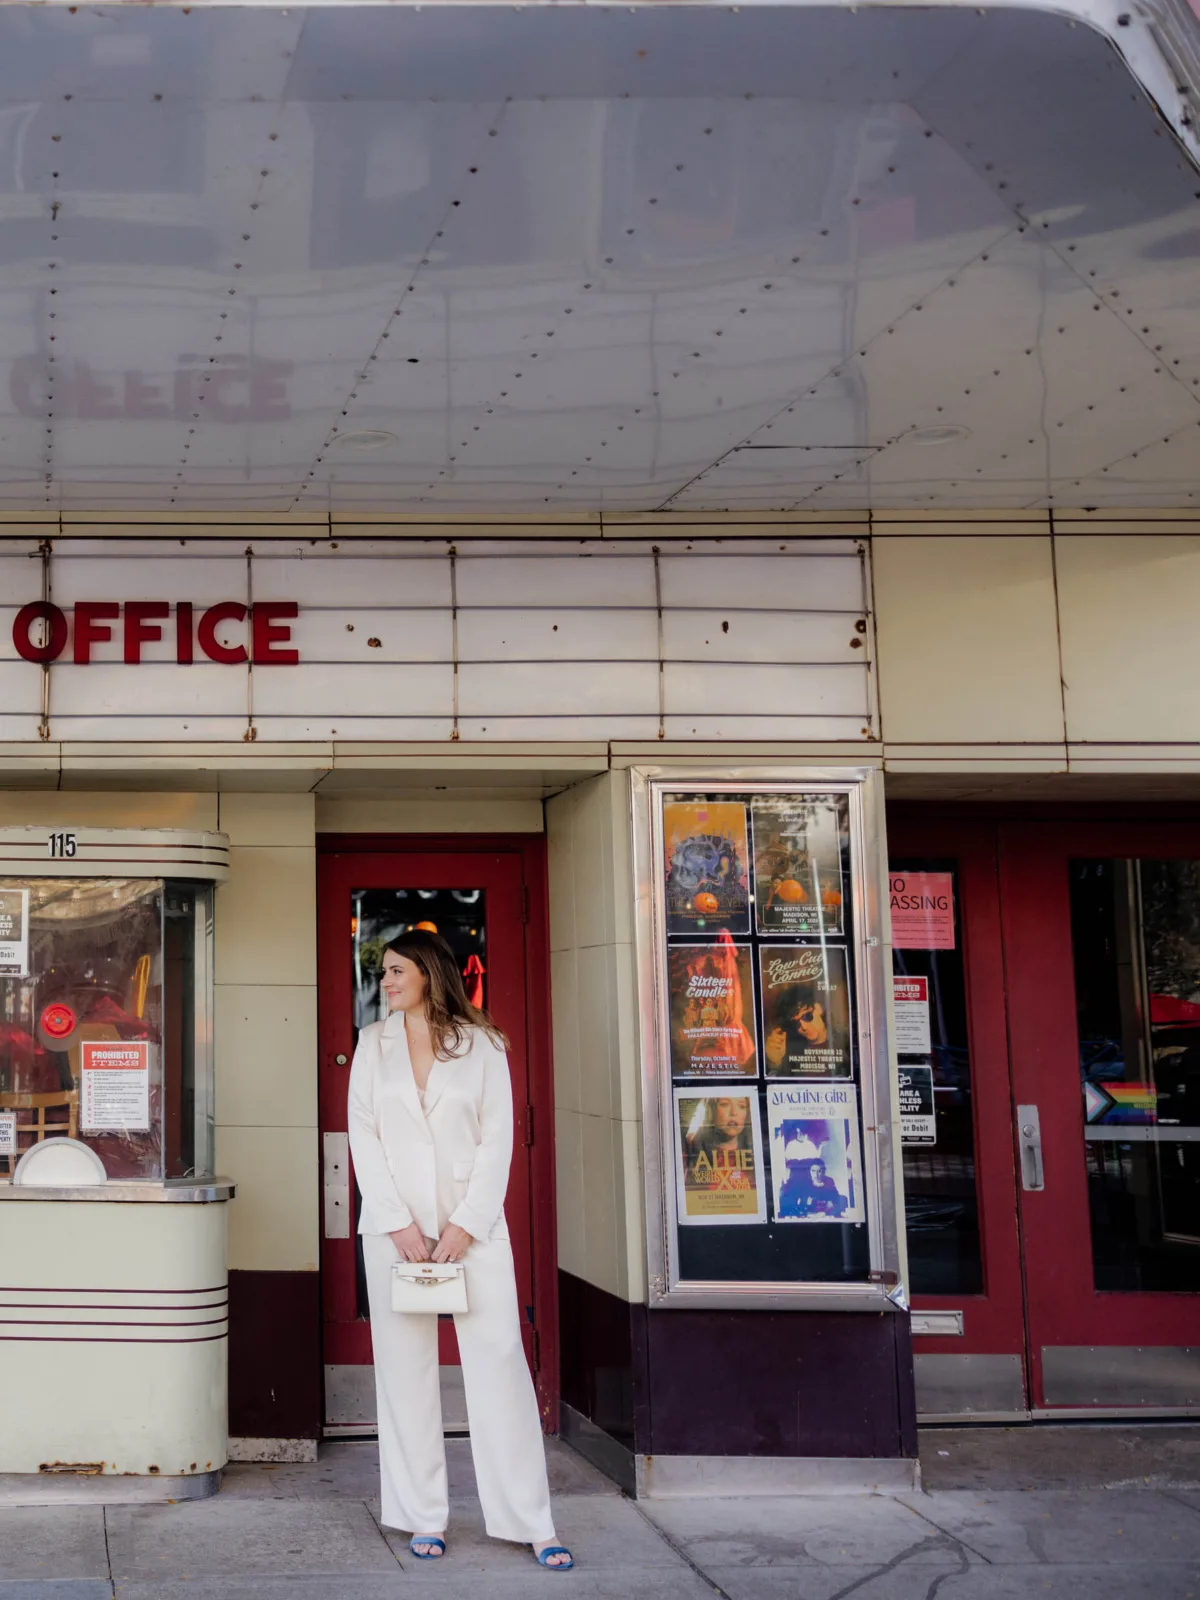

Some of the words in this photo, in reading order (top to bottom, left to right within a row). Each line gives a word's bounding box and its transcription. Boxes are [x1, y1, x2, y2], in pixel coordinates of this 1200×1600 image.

[12, 600, 299, 665] OFFICE
[48, 833, 76, 857] 115
[890, 878, 905, 892] O
[890, 896, 948, 910] ASSING
[767, 959, 798, 973] Low
[689, 975, 733, 986] Sixteen
[771, 966, 821, 984] Connie
[772, 1089, 824, 1105] MACHINE
[825, 1089, 848, 1103] GIRL
[695, 1150, 754, 1171] ALLIE
